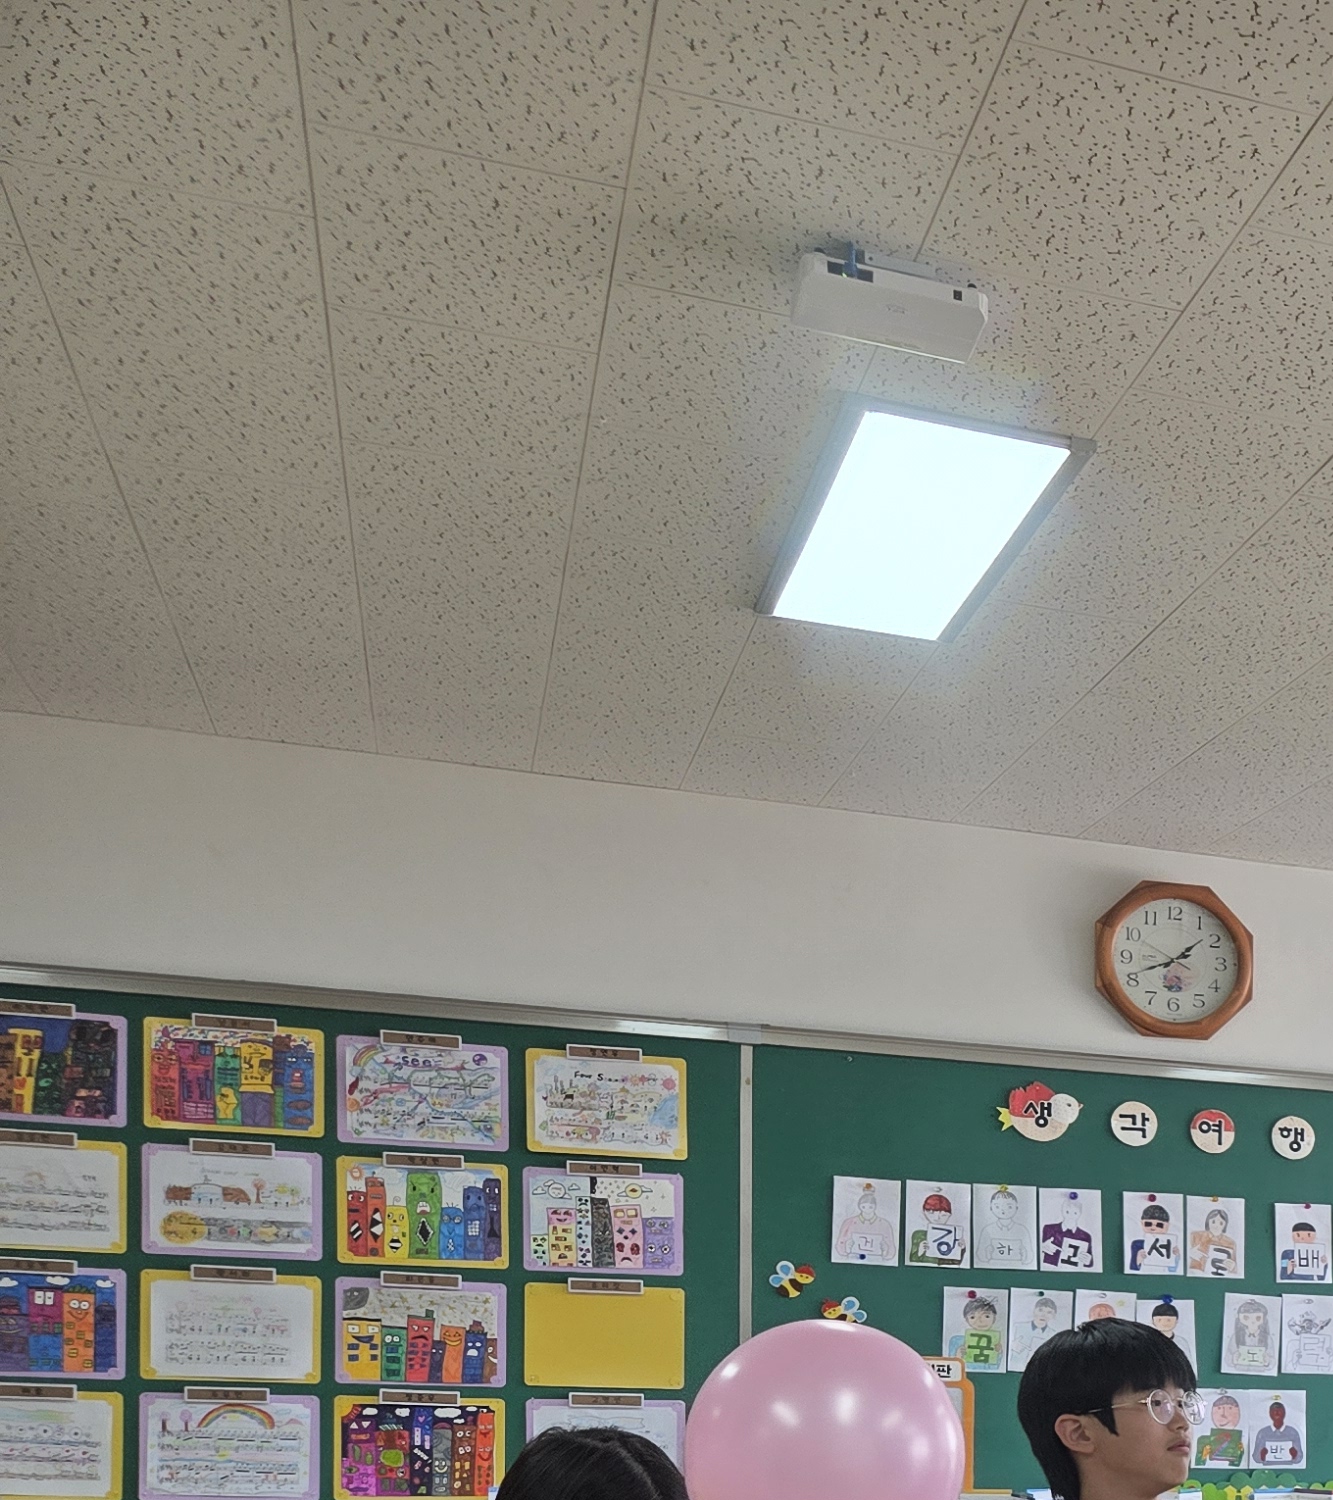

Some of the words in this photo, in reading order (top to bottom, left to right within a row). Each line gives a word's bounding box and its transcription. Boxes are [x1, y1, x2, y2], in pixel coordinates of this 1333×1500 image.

[1144, 910, 1158, 926] 11
[1167, 906, 1183, 921] 12
[1197, 916, 1202, 931] 1
[1125, 926, 1141, 941] 10
[1209, 933, 1221, 949] 2
[1120, 949, 1133, 965] 9
[1215, 957, 1228, 972] 3
[1126, 973, 1140, 988] 8
[1208, 978, 1221, 993] 4
[1145, 990, 1158, 1006] 7
[1167, 997, 1180, 1012] 6
[1193, 994, 1206, 1009] 5
[1023, 1100, 1053, 1128] 생
[1118, 1112, 1150, 1140] 각
[1198, 1118, 1223, 1146] 여
[1278, 1125, 1306, 1153] 행
[931, 1226, 959, 1256] 강
[996, 1242, 1014, 1256] 하
[1060, 1244, 1080, 1266] 고
[1146, 1239, 1172, 1260] 서
[1211, 1248, 1232, 1276] 로
[1298, 1250, 1320, 1269] 배
[967, 1332, 996, 1363] 꿈
[1247, 1349, 1263, 1363] 노
[1269, 1444, 1285, 1460] 반
